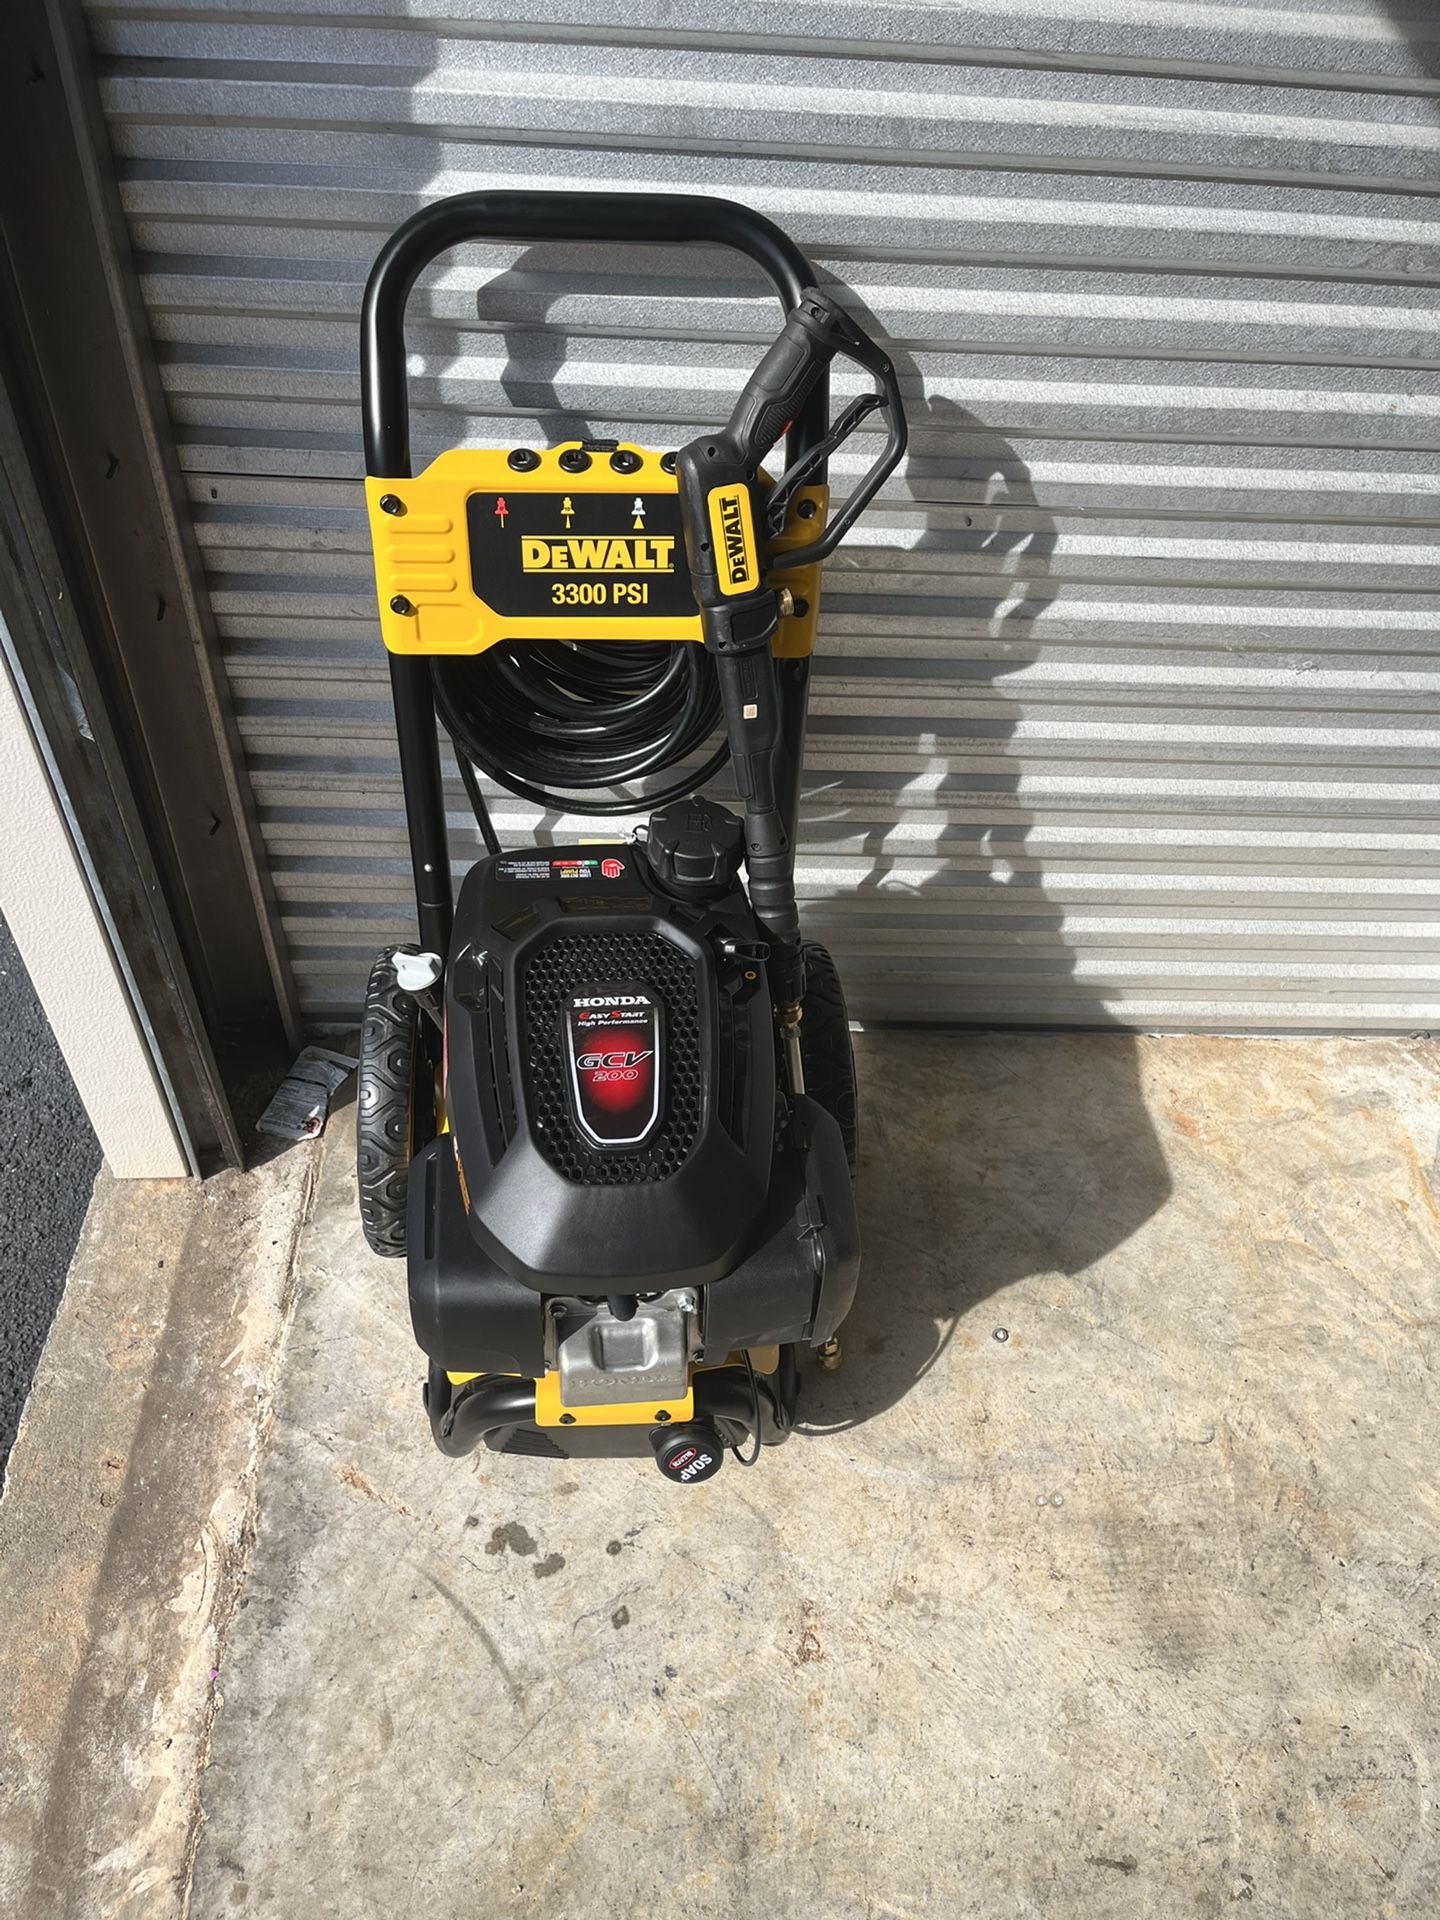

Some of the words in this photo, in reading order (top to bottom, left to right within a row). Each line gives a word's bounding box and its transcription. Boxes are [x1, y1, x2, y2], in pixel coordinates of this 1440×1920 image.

[722, 497, 748, 584] DEWALT
[522, 539, 674, 569] DEWALT
[552, 583, 606, 605] 3300
[613, 583, 648, 605] PSI
[573, 996, 652, 1008] HONDA
[577, 1050, 654, 1070] GCV
[592, 1069, 639, 1082] 200
[681, 1454, 712, 1480] SOAP
